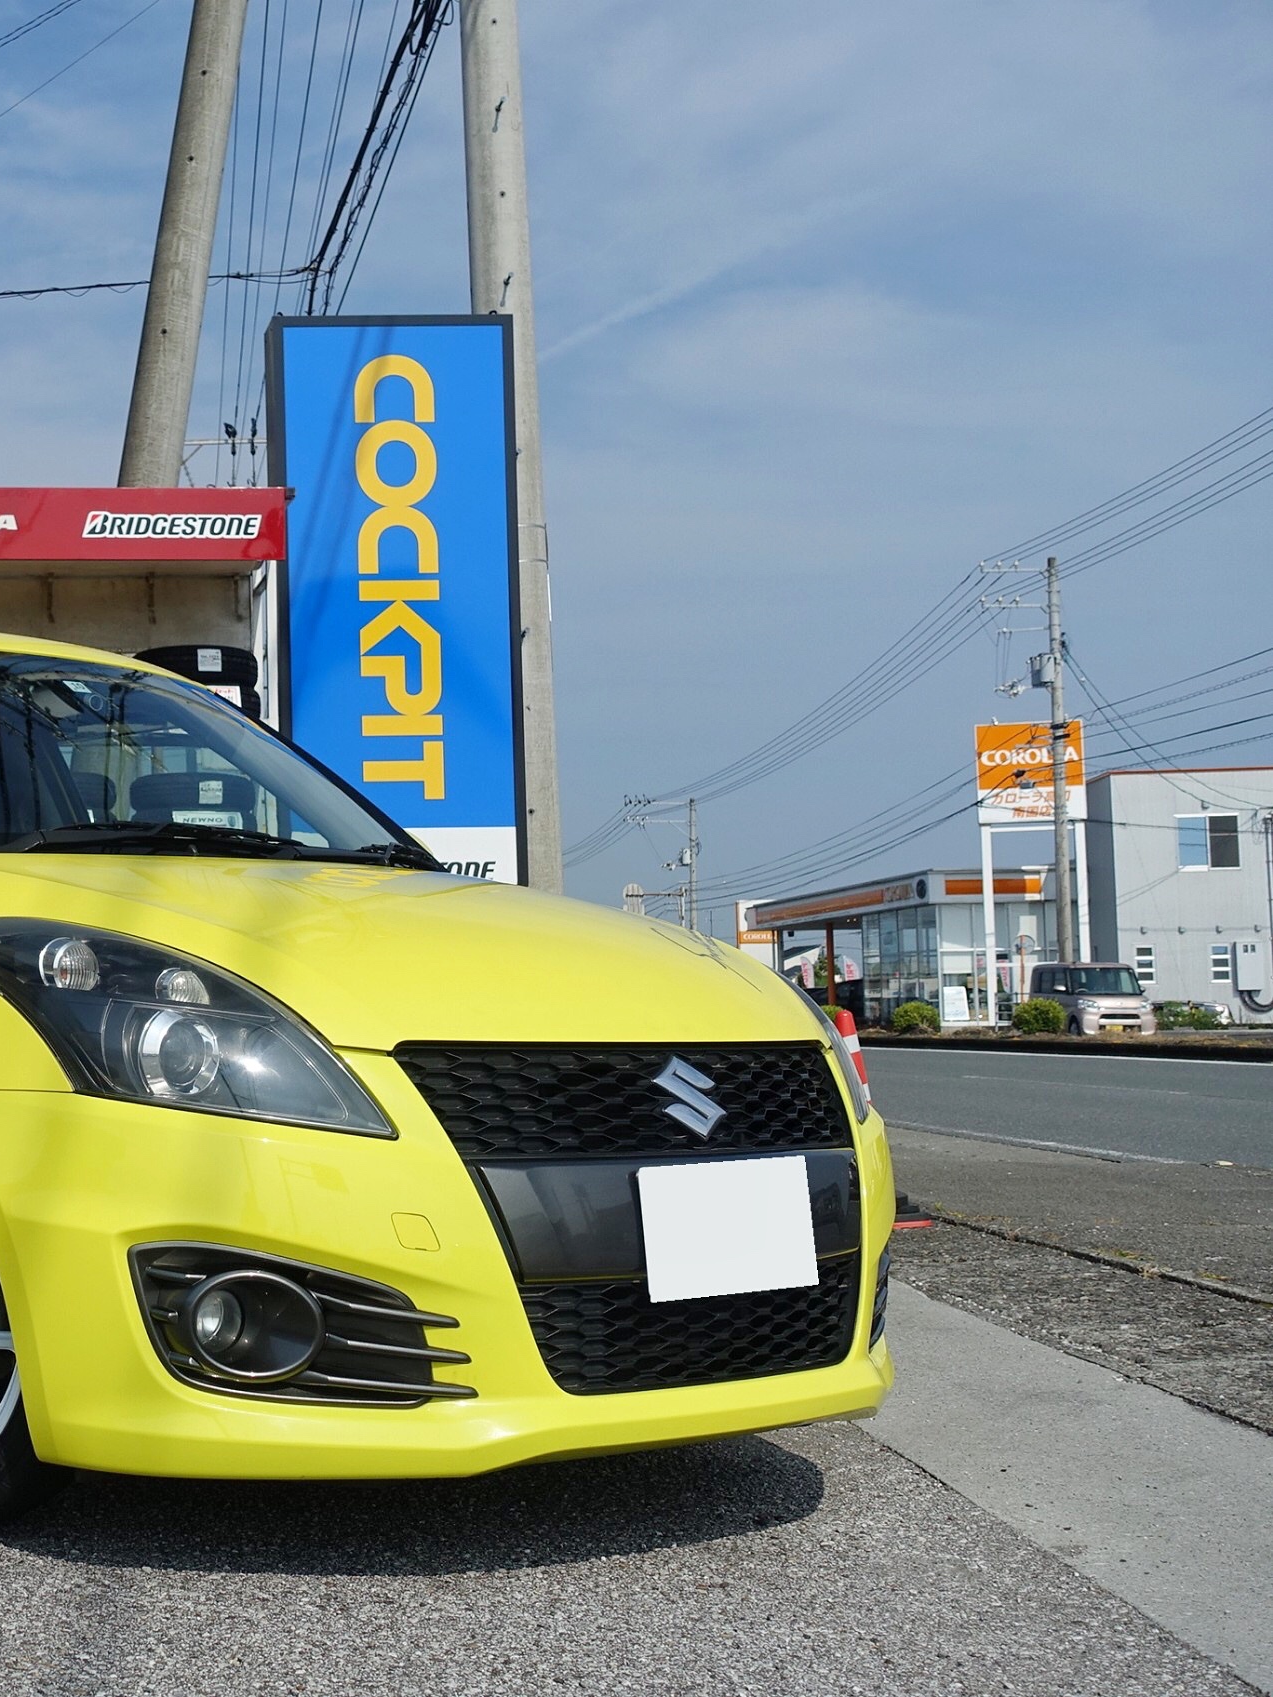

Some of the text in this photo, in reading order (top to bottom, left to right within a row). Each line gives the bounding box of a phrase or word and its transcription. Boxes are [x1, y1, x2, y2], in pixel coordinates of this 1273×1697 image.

[82, 510, 261, 539] BRIDGESTONE
[354, 354, 446, 801] COCKPIT
[980, 746, 1080, 767] COROLA
